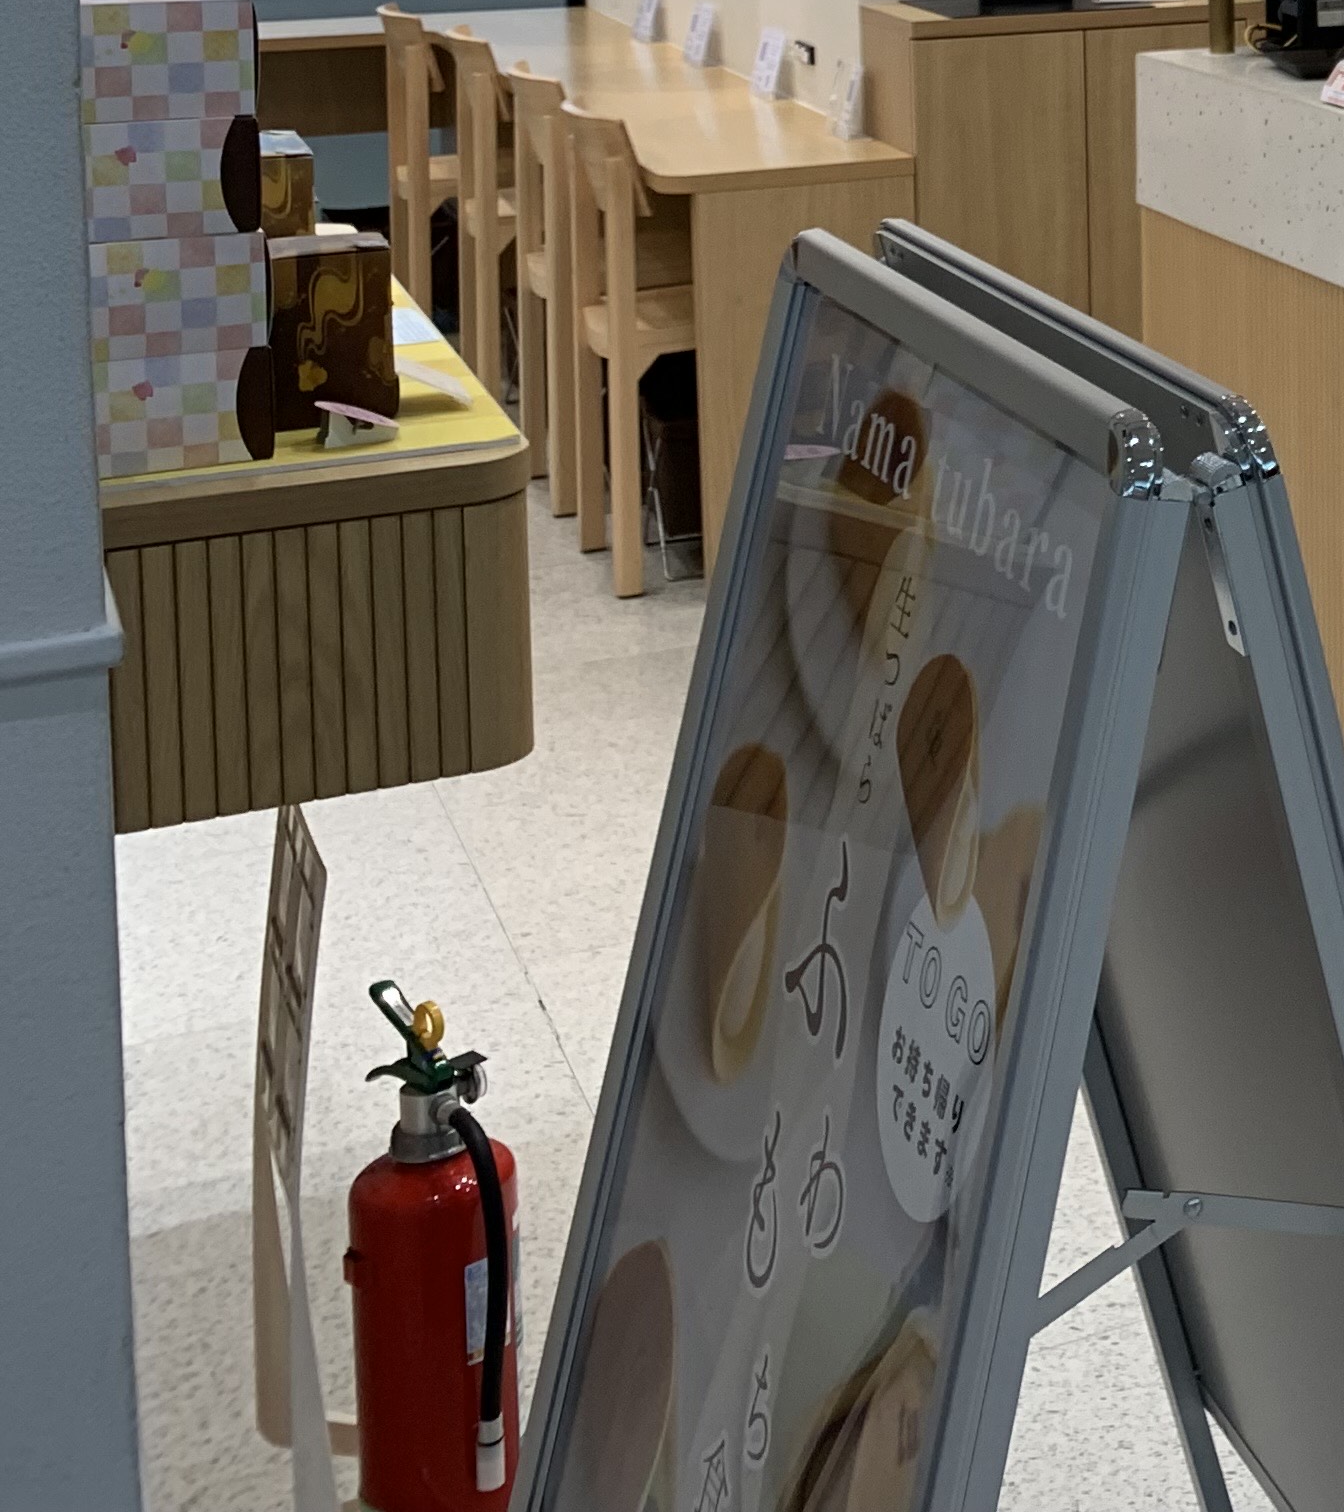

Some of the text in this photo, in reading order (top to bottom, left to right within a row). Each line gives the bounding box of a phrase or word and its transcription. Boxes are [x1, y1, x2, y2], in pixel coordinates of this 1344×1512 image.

[817, 352, 1073, 620] Nama tubara
[857, 576, 916, 805] 生つばら
[891, 1025, 965, 1135] お持ち帰り
